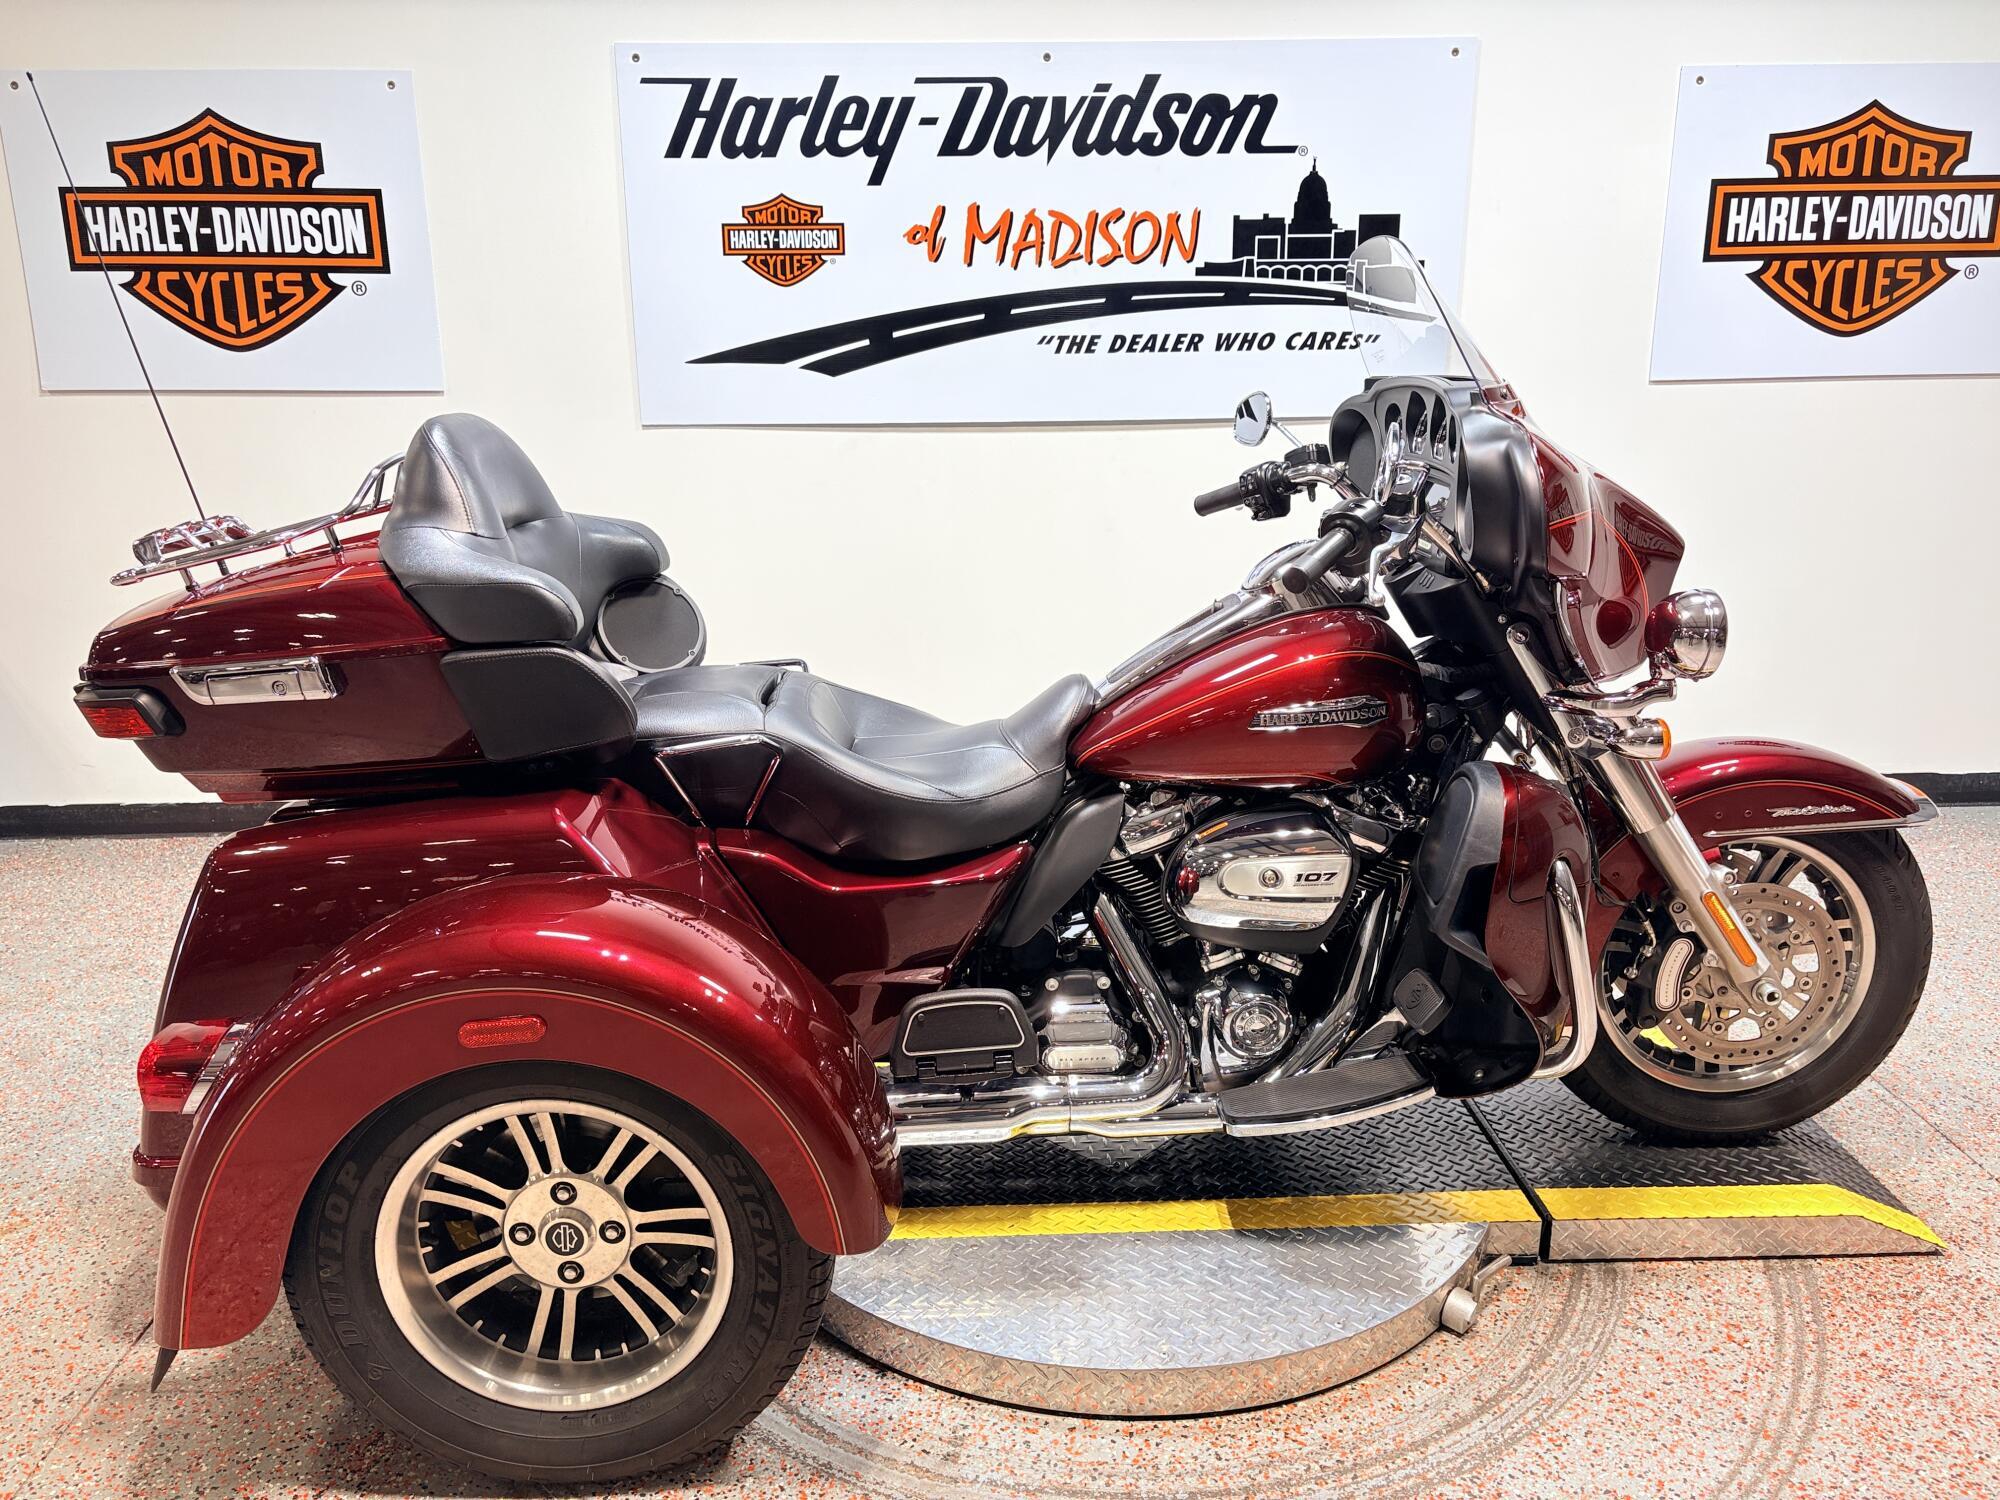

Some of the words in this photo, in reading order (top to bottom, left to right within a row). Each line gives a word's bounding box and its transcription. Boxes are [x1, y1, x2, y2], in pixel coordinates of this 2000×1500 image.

[640, 74, 1298, 186] Harley-Davidson
[1799, 123, 1938, 177] MOTOR
[143, 131, 291, 188] MOTOR
[84, 206, 368, 255] HARLEY-DAVIDSON
[755, 201, 812, 224] MOTOR
[963, 201, 1201, 270] MADISON
[1726, 194, 1994, 243] HARLEY-DAVIDSON
[730, 229, 838, 249] HARLEY-DAVIDSON
[756, 255, 813, 281] CYCLES
[1784, 258, 1923, 320] CYCLES
[157, 271, 305, 335] CYCLES
[1037, 334, 1101, 354] "THE
[1107, 333, 1204, 353] DEALER
[1214, 331, 1276, 352] WHO
[1260, 706, 1387, 726] HARLEY-DAVIDSON
[1295, 872, 1338, 882] 107
[319, 1160, 368, 1347] DUNLOP
